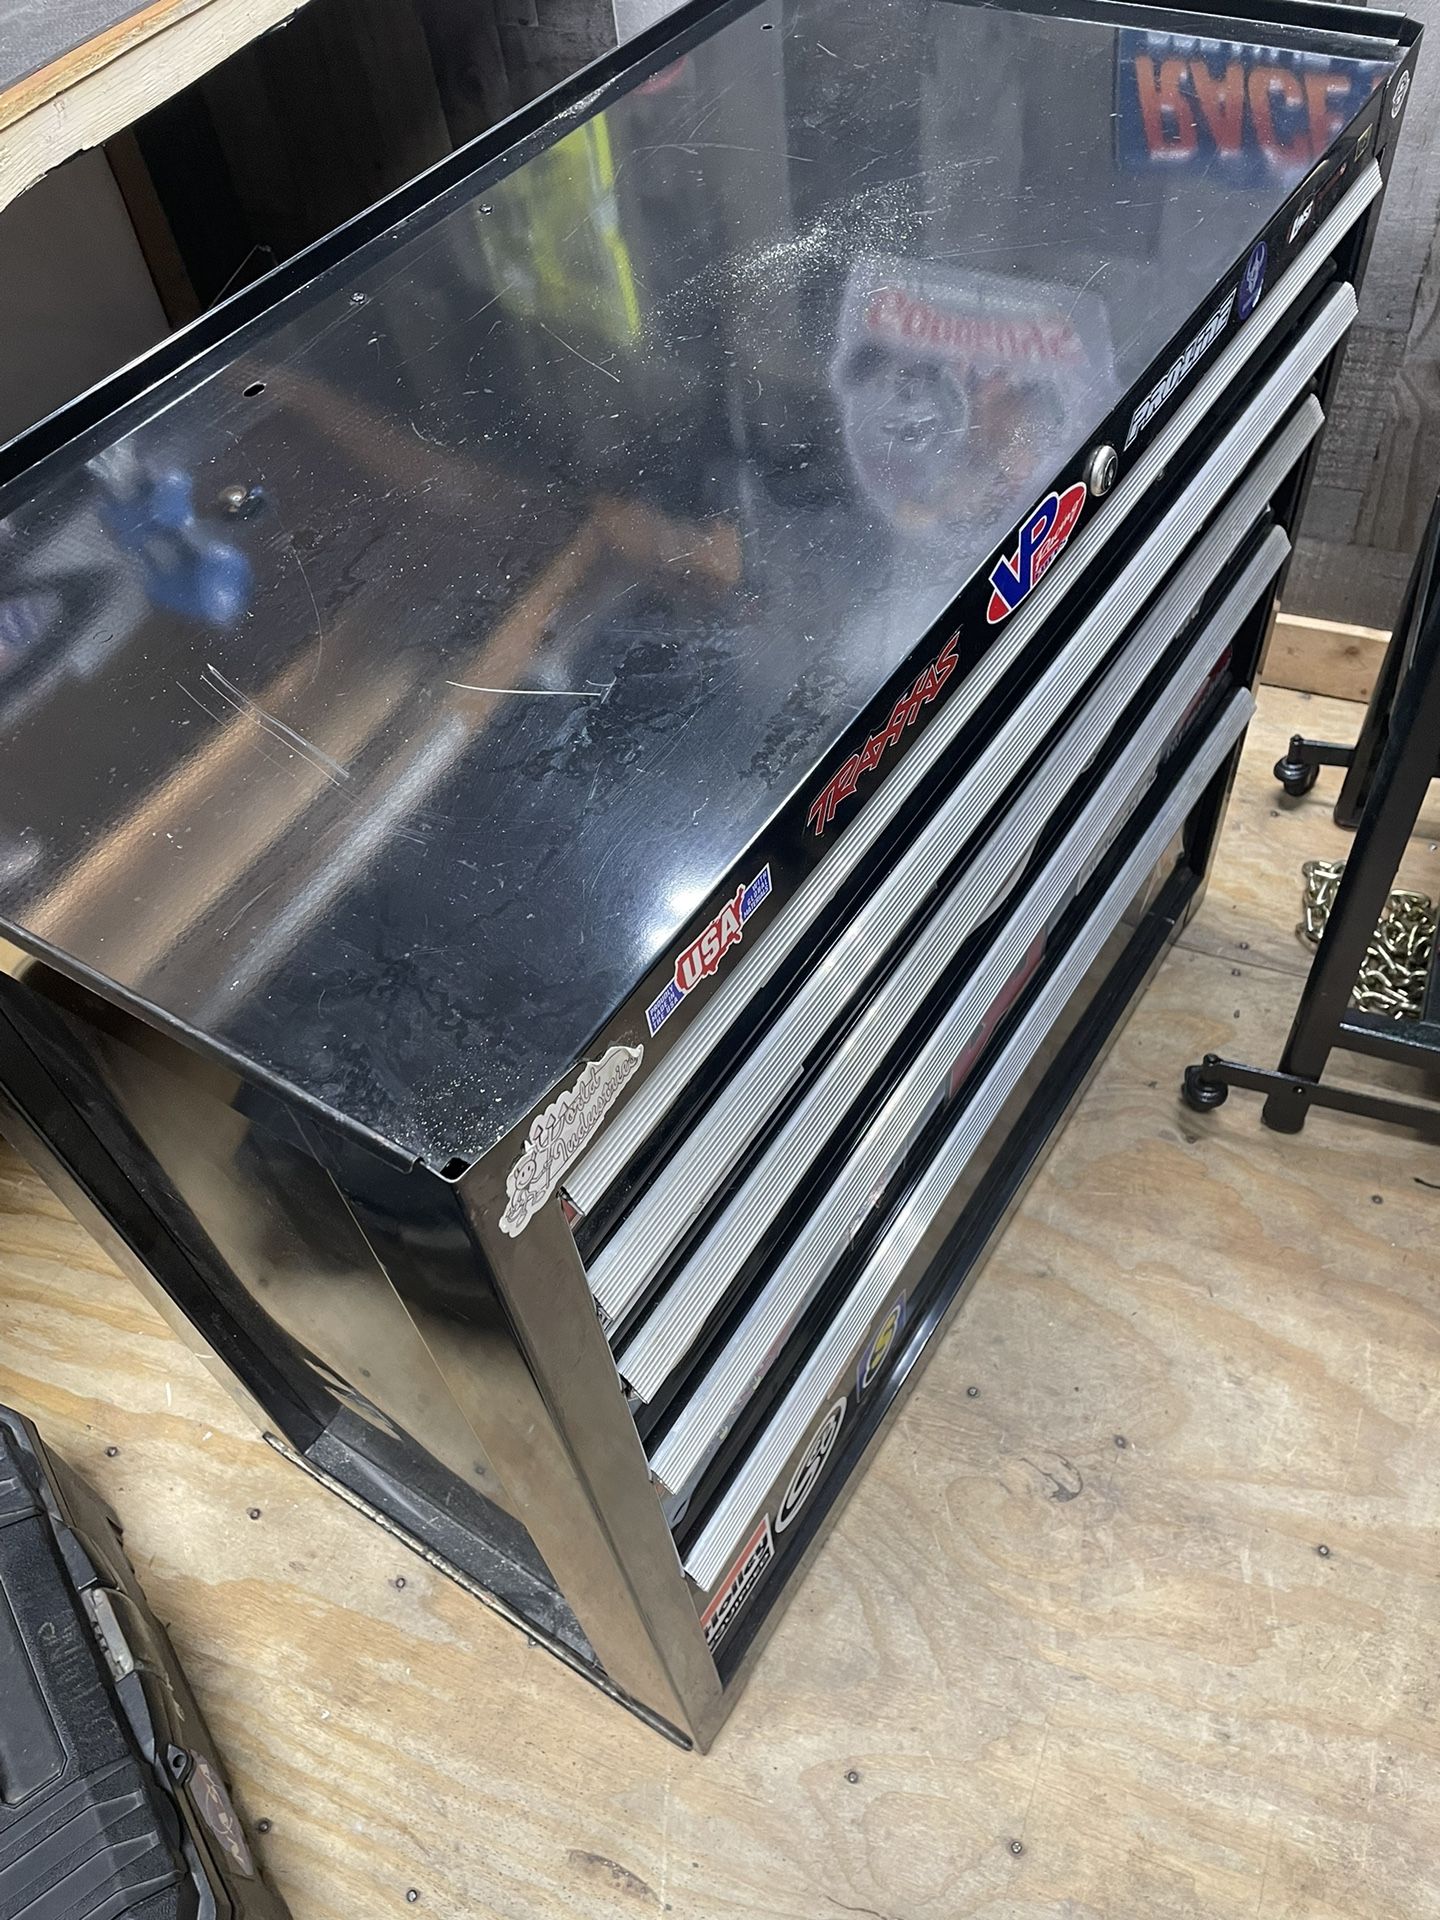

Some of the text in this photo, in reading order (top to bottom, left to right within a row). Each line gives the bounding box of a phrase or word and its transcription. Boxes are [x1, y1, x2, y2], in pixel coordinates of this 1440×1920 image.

[988, 491, 1060, 610] VP
[806, 630, 960, 836] TRAXXAS
[743, 885, 769, 919] MATERIALS
[752, 870, 767, 891] WITH
[681, 905, 740, 988] USA
[650, 983, 675, 1017] PROUDLY
[652, 1000, 668, 1022] MADE
[533, 1068, 601, 1152] World
[550, 1056, 639, 1162] Industries
[704, 1533, 769, 1640] Holley
